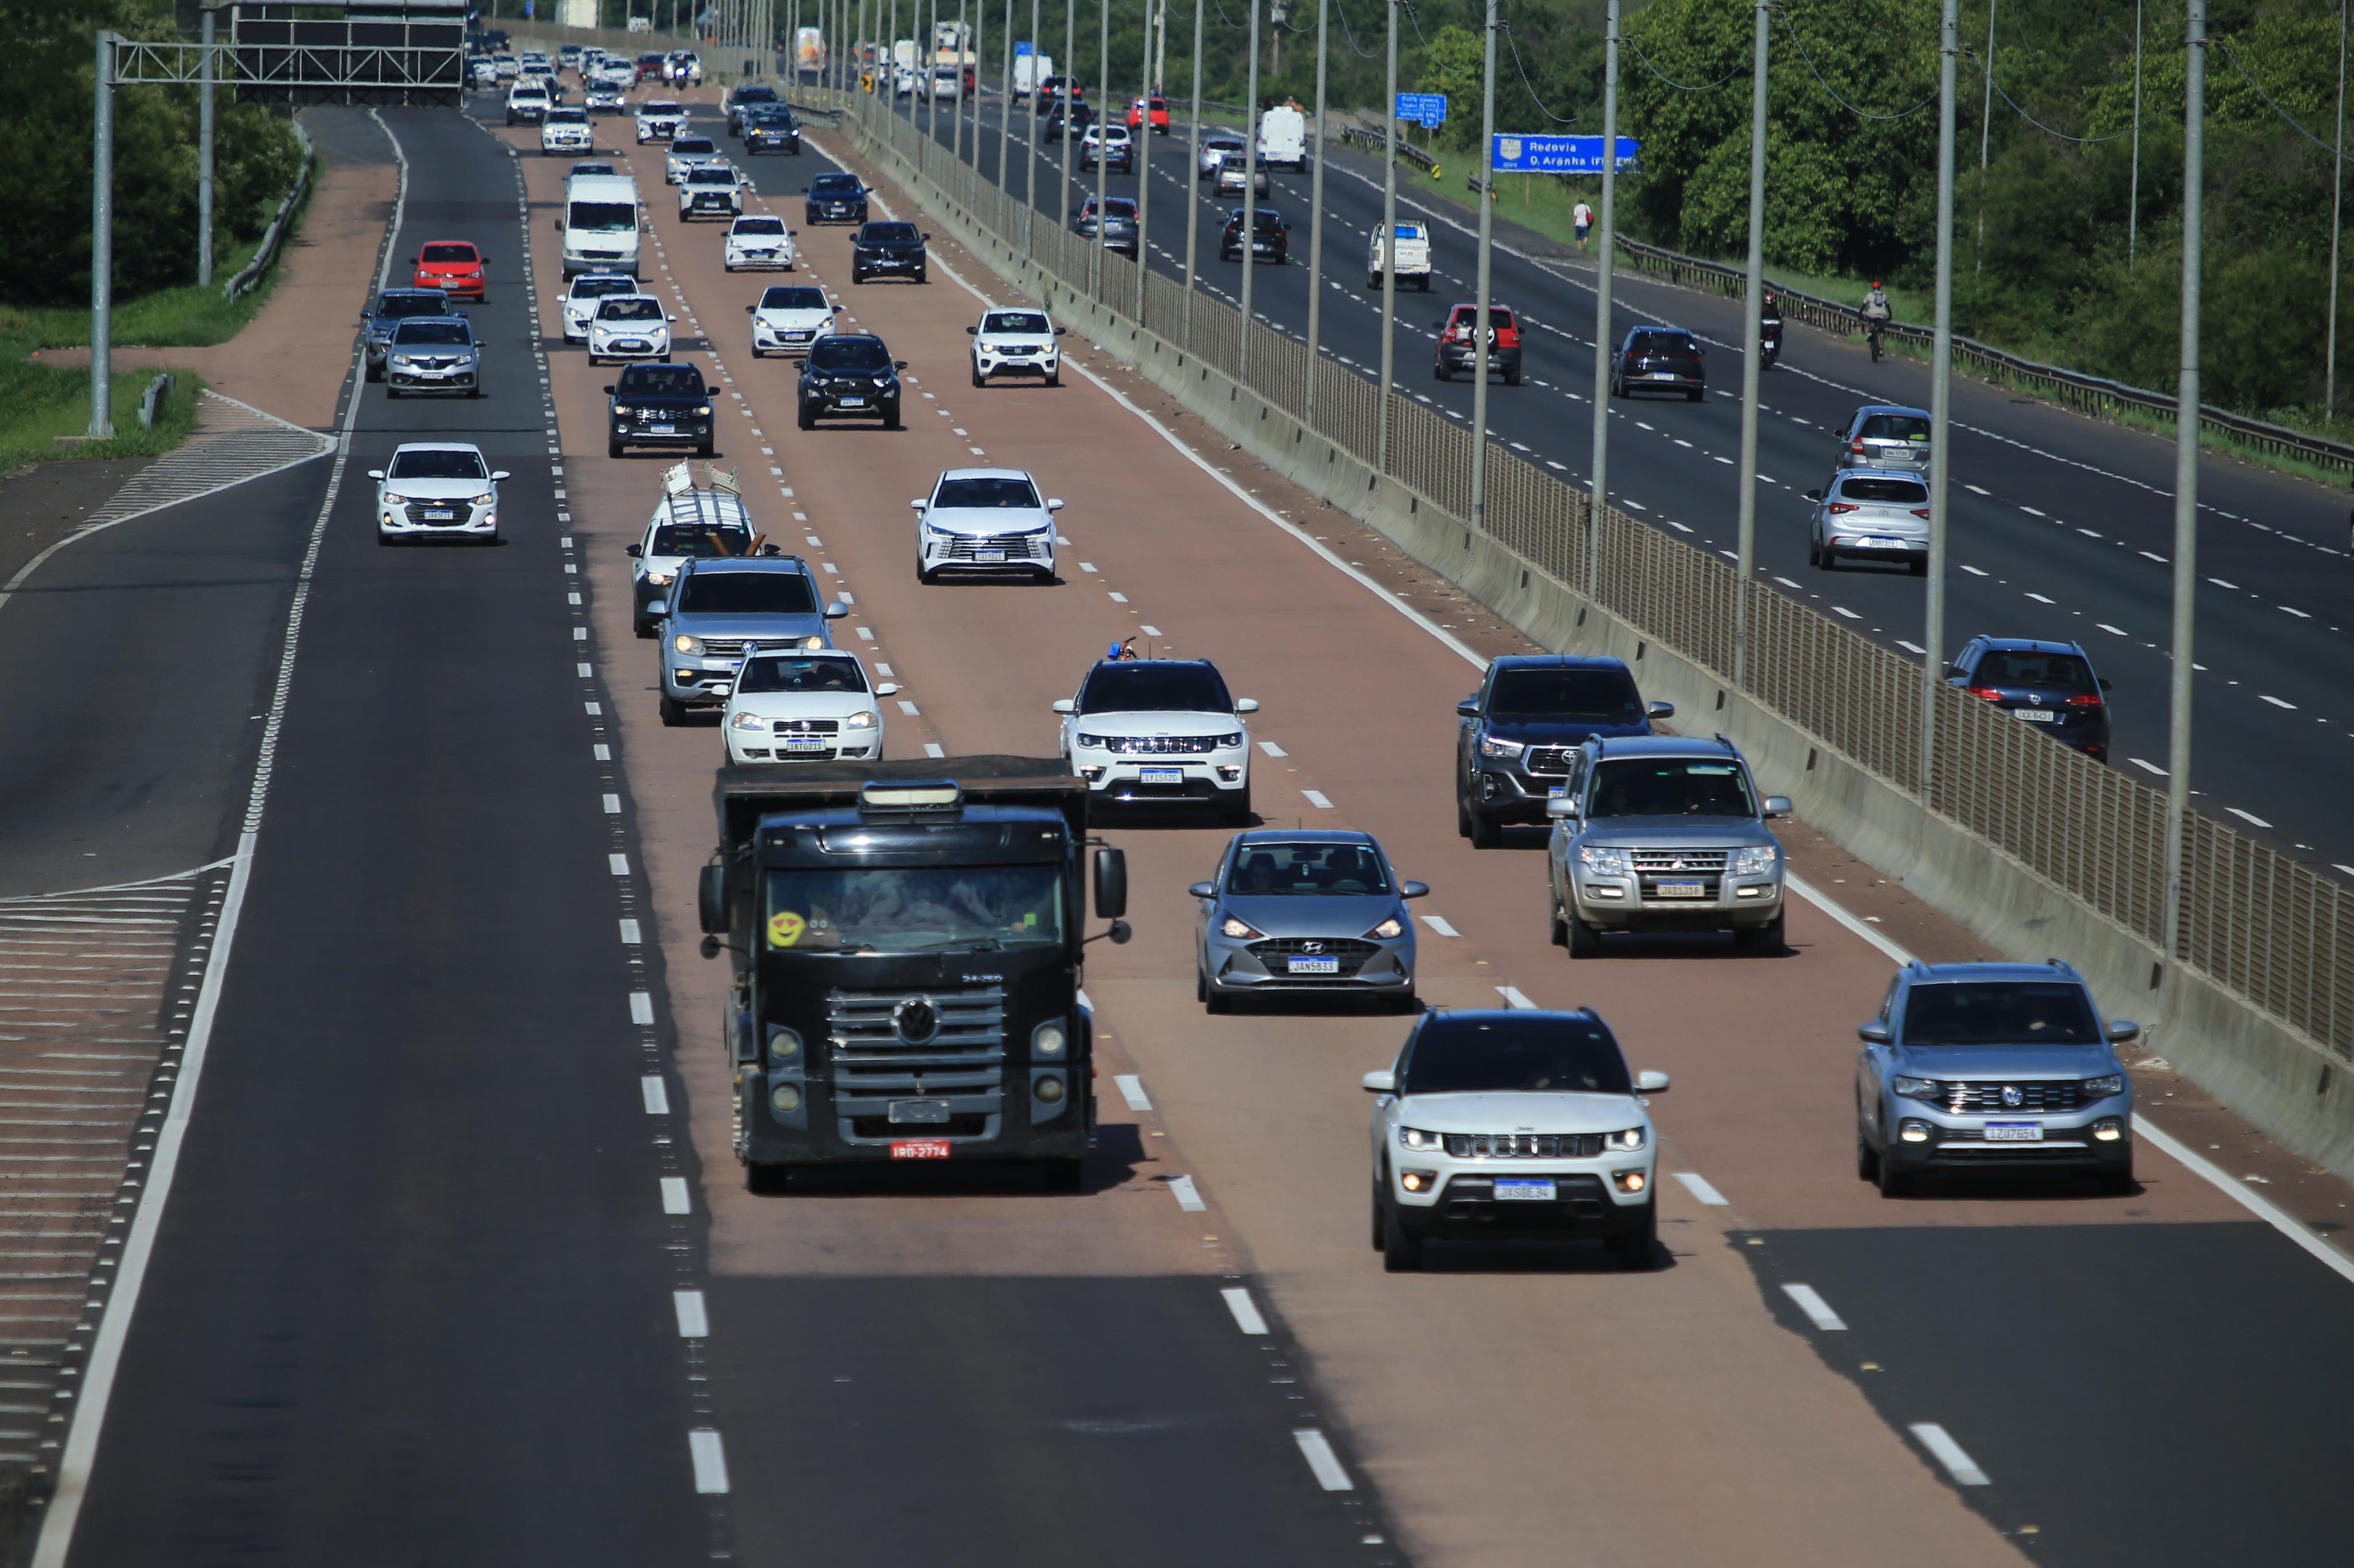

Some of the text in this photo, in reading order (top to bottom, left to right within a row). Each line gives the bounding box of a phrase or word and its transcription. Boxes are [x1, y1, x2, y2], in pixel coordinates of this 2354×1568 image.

[1529, 142, 1577, 152] Rodovia
[1543, 156, 1586, 166] Aranha
[1294, 963, 1334, 971] JAN5B33
